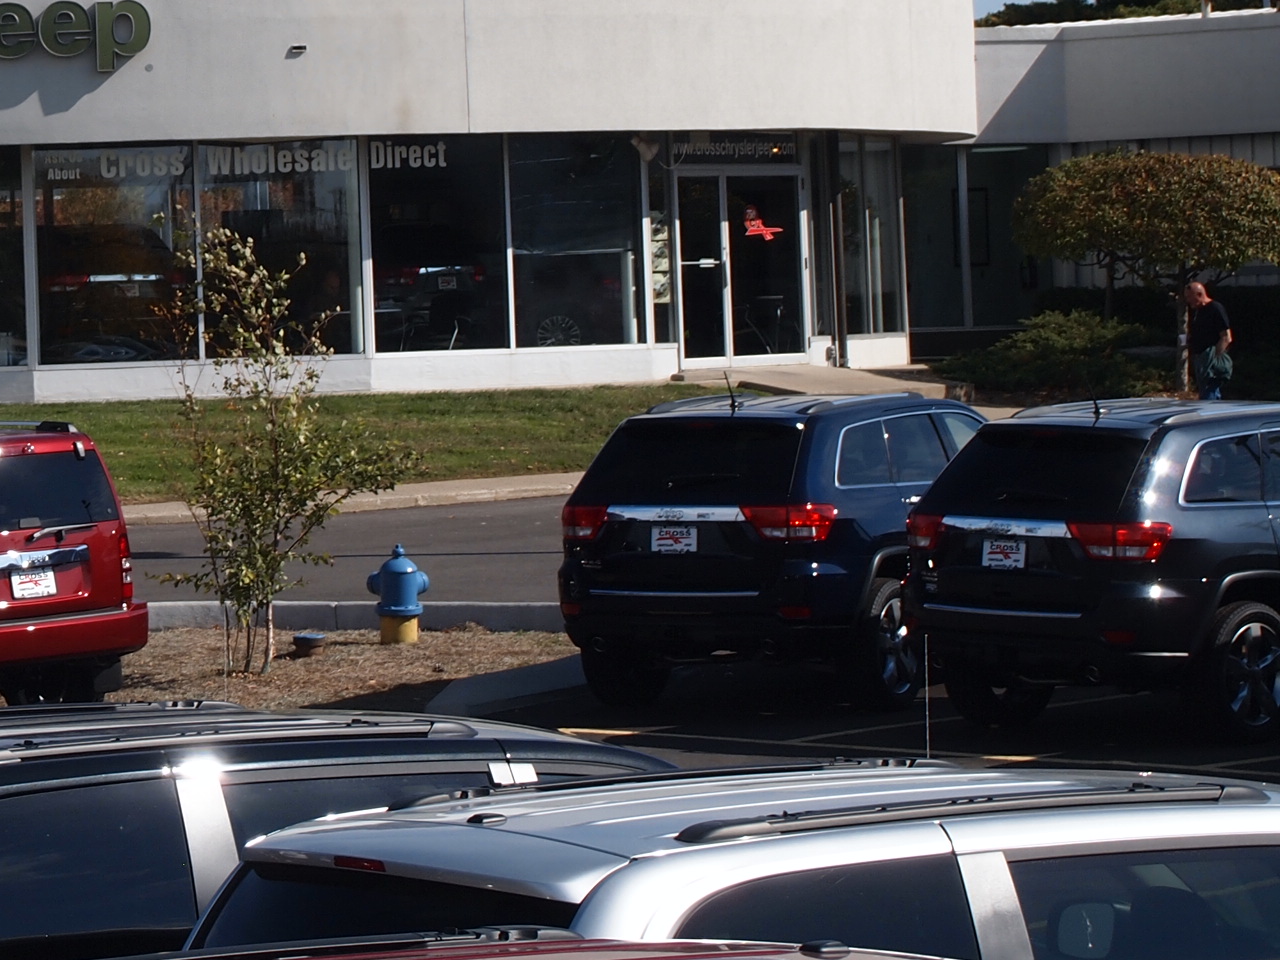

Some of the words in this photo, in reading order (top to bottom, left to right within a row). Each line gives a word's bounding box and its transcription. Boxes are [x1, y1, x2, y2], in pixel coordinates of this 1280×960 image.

[100, 149, 185, 179] Cross
[206, 144, 353, 176] Wholesale
[370, 141, 448, 169] Direct
[47, 168, 81, 180] About
[658, 530, 692, 539] CROSS
[990, 543, 1020, 553] CROSS
[18, 572, 49, 581] CROSS
